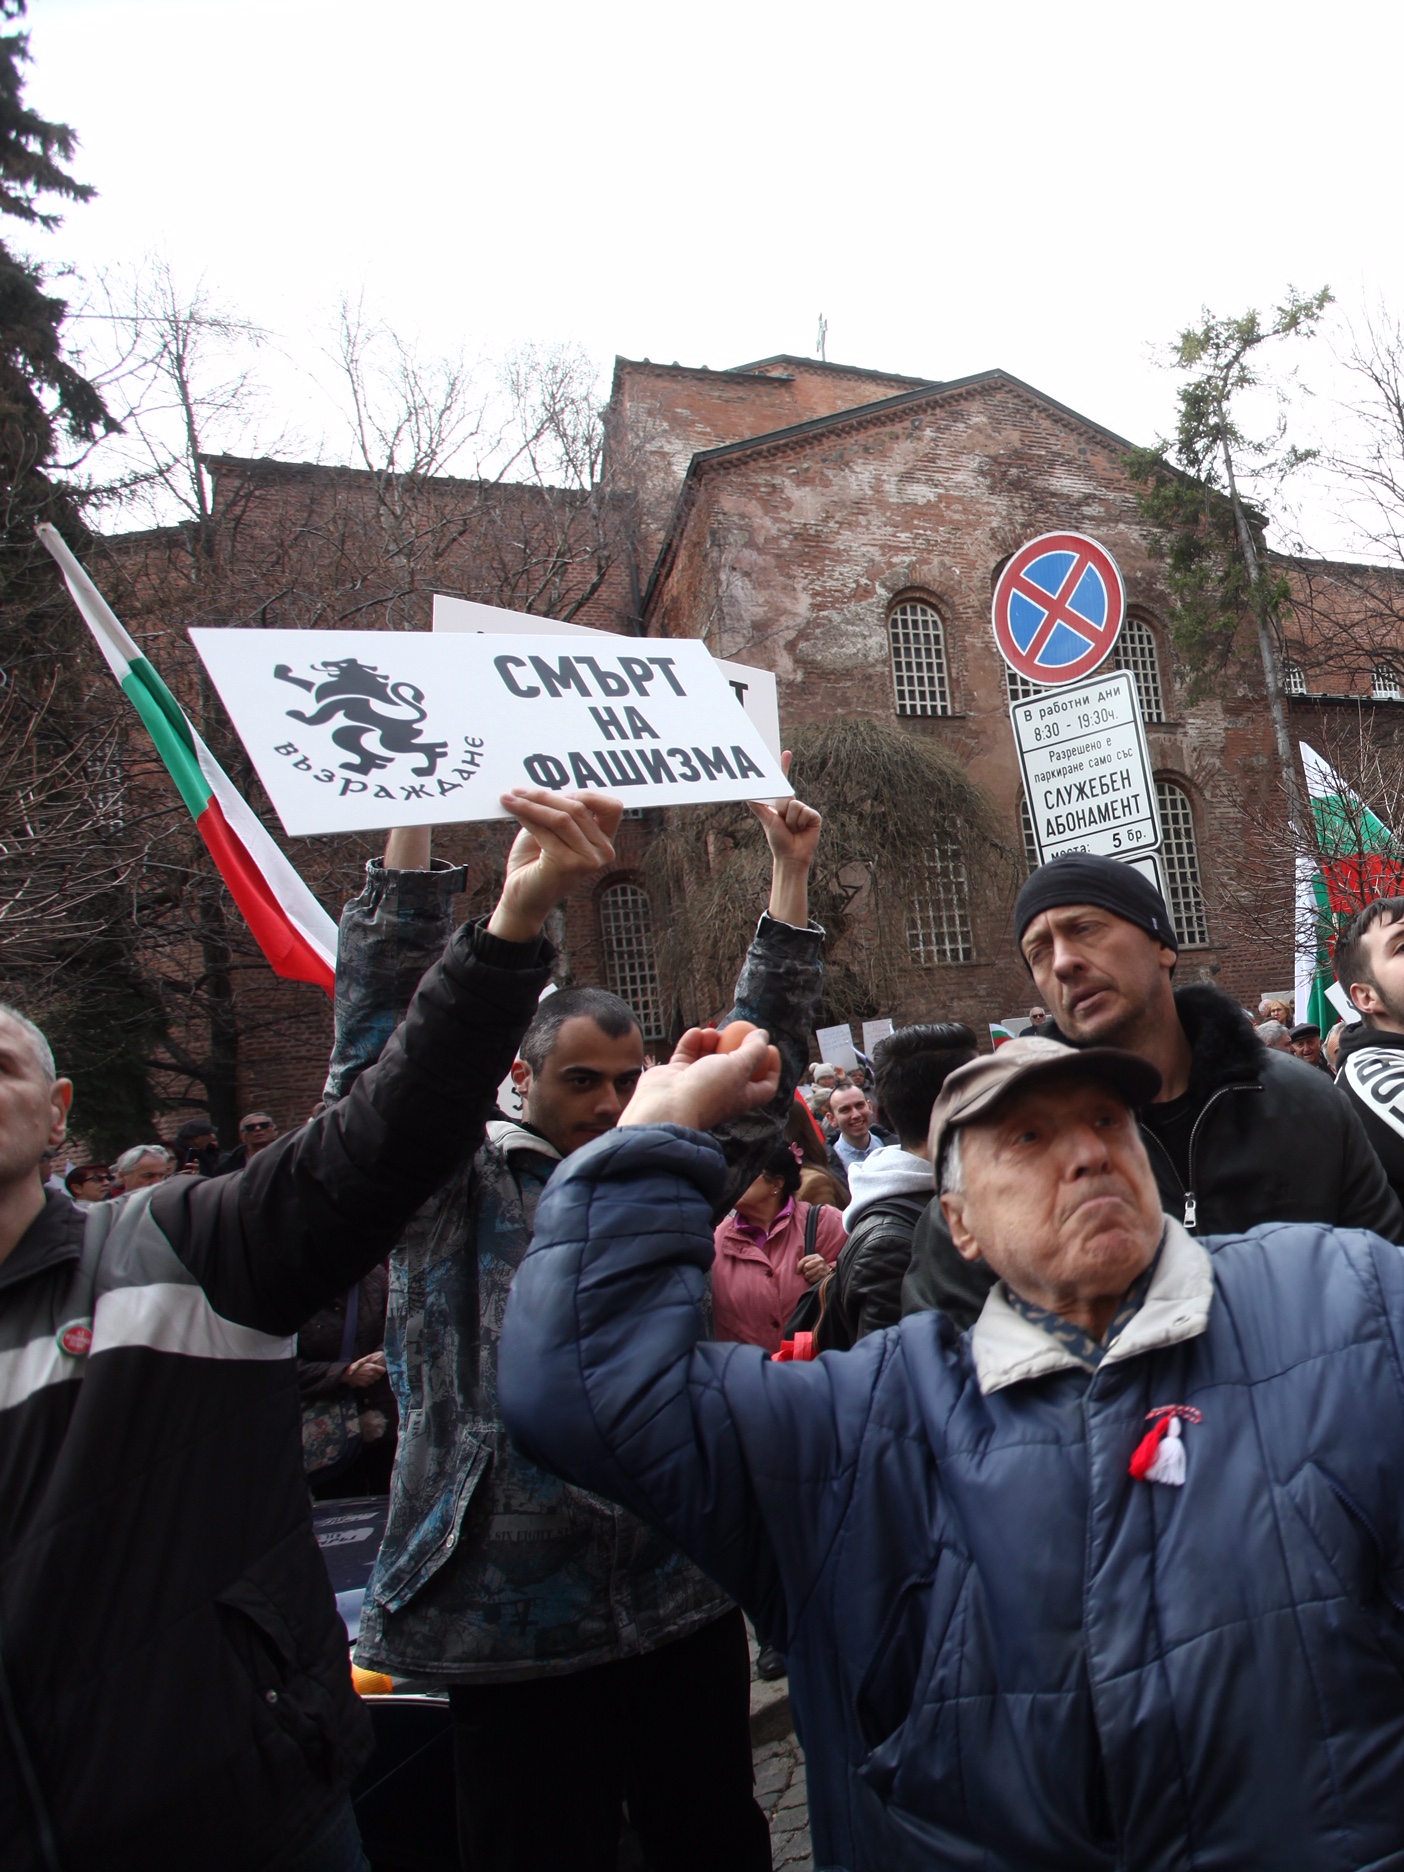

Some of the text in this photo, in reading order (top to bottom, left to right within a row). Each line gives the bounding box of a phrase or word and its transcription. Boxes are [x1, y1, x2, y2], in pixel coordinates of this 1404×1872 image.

[493, 654, 688, 698] СМЪРТ
[1024, 686, 1121, 723] В работни дни
[588, 706, 661, 741] НА
[1034, 722, 1060, 742] 8:30
[523, 745, 766, 790] ФАШИЗМА
[1034, 747, 1133, 783] паркиране само със
[1048, 737, 1112, 763] Разрешено е
[1044, 769, 1132, 809] СЛУЖЕБЕН
[1046, 794, 1141, 838] АБОНАМЕНТ
[1112, 833, 1122, 848] 5
[1127, 828, 1147, 844] бр.
